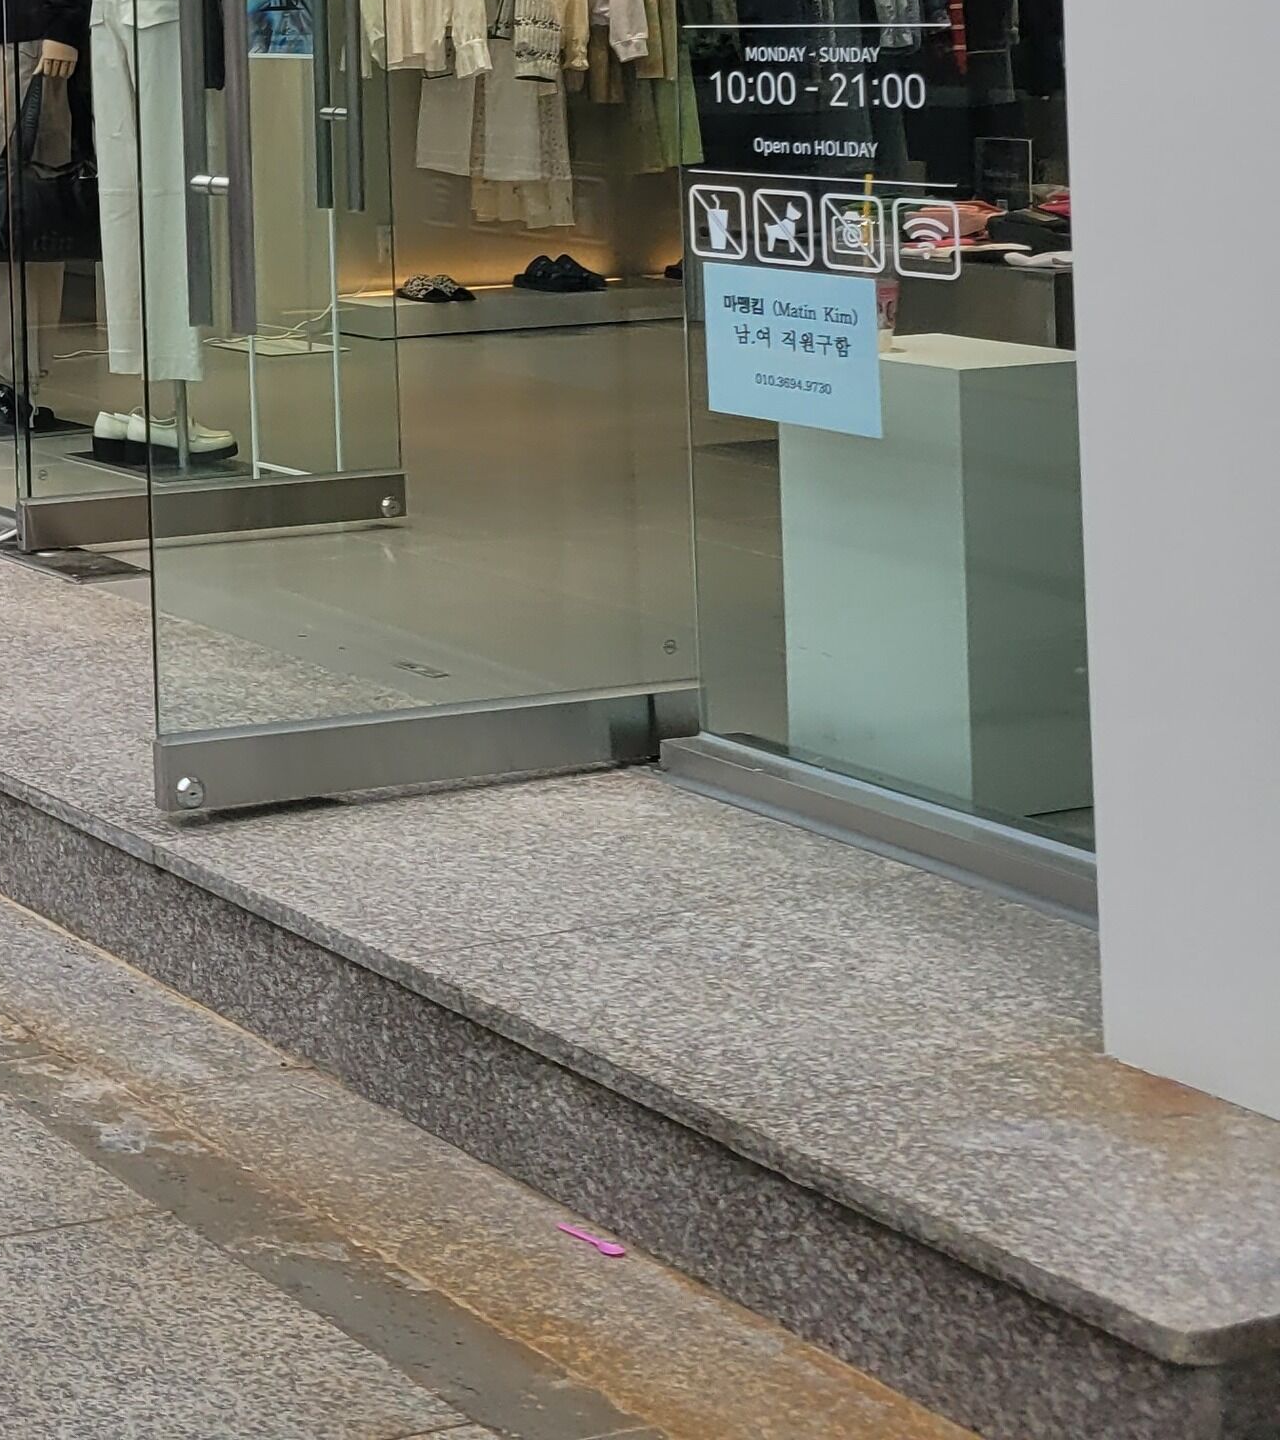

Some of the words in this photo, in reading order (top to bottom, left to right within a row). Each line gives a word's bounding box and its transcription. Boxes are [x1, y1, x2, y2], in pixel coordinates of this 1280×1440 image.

[745, 47, 804, 63] MONDAY
[819, 47, 880, 63] SUNDAY
[709, 71, 796, 106] 10:00
[829, 73, 926, 109] 21:00
[753, 137, 788, 157] Open
[792, 142, 811, 155] on
[814, 139, 878, 158] HOLIDAY
[772, 299, 817, 321] (Matin
[823, 306, 859, 326] Kim)
[734, 323, 771, 349] 남.여
[781, 330, 852, 358] 직원구함
